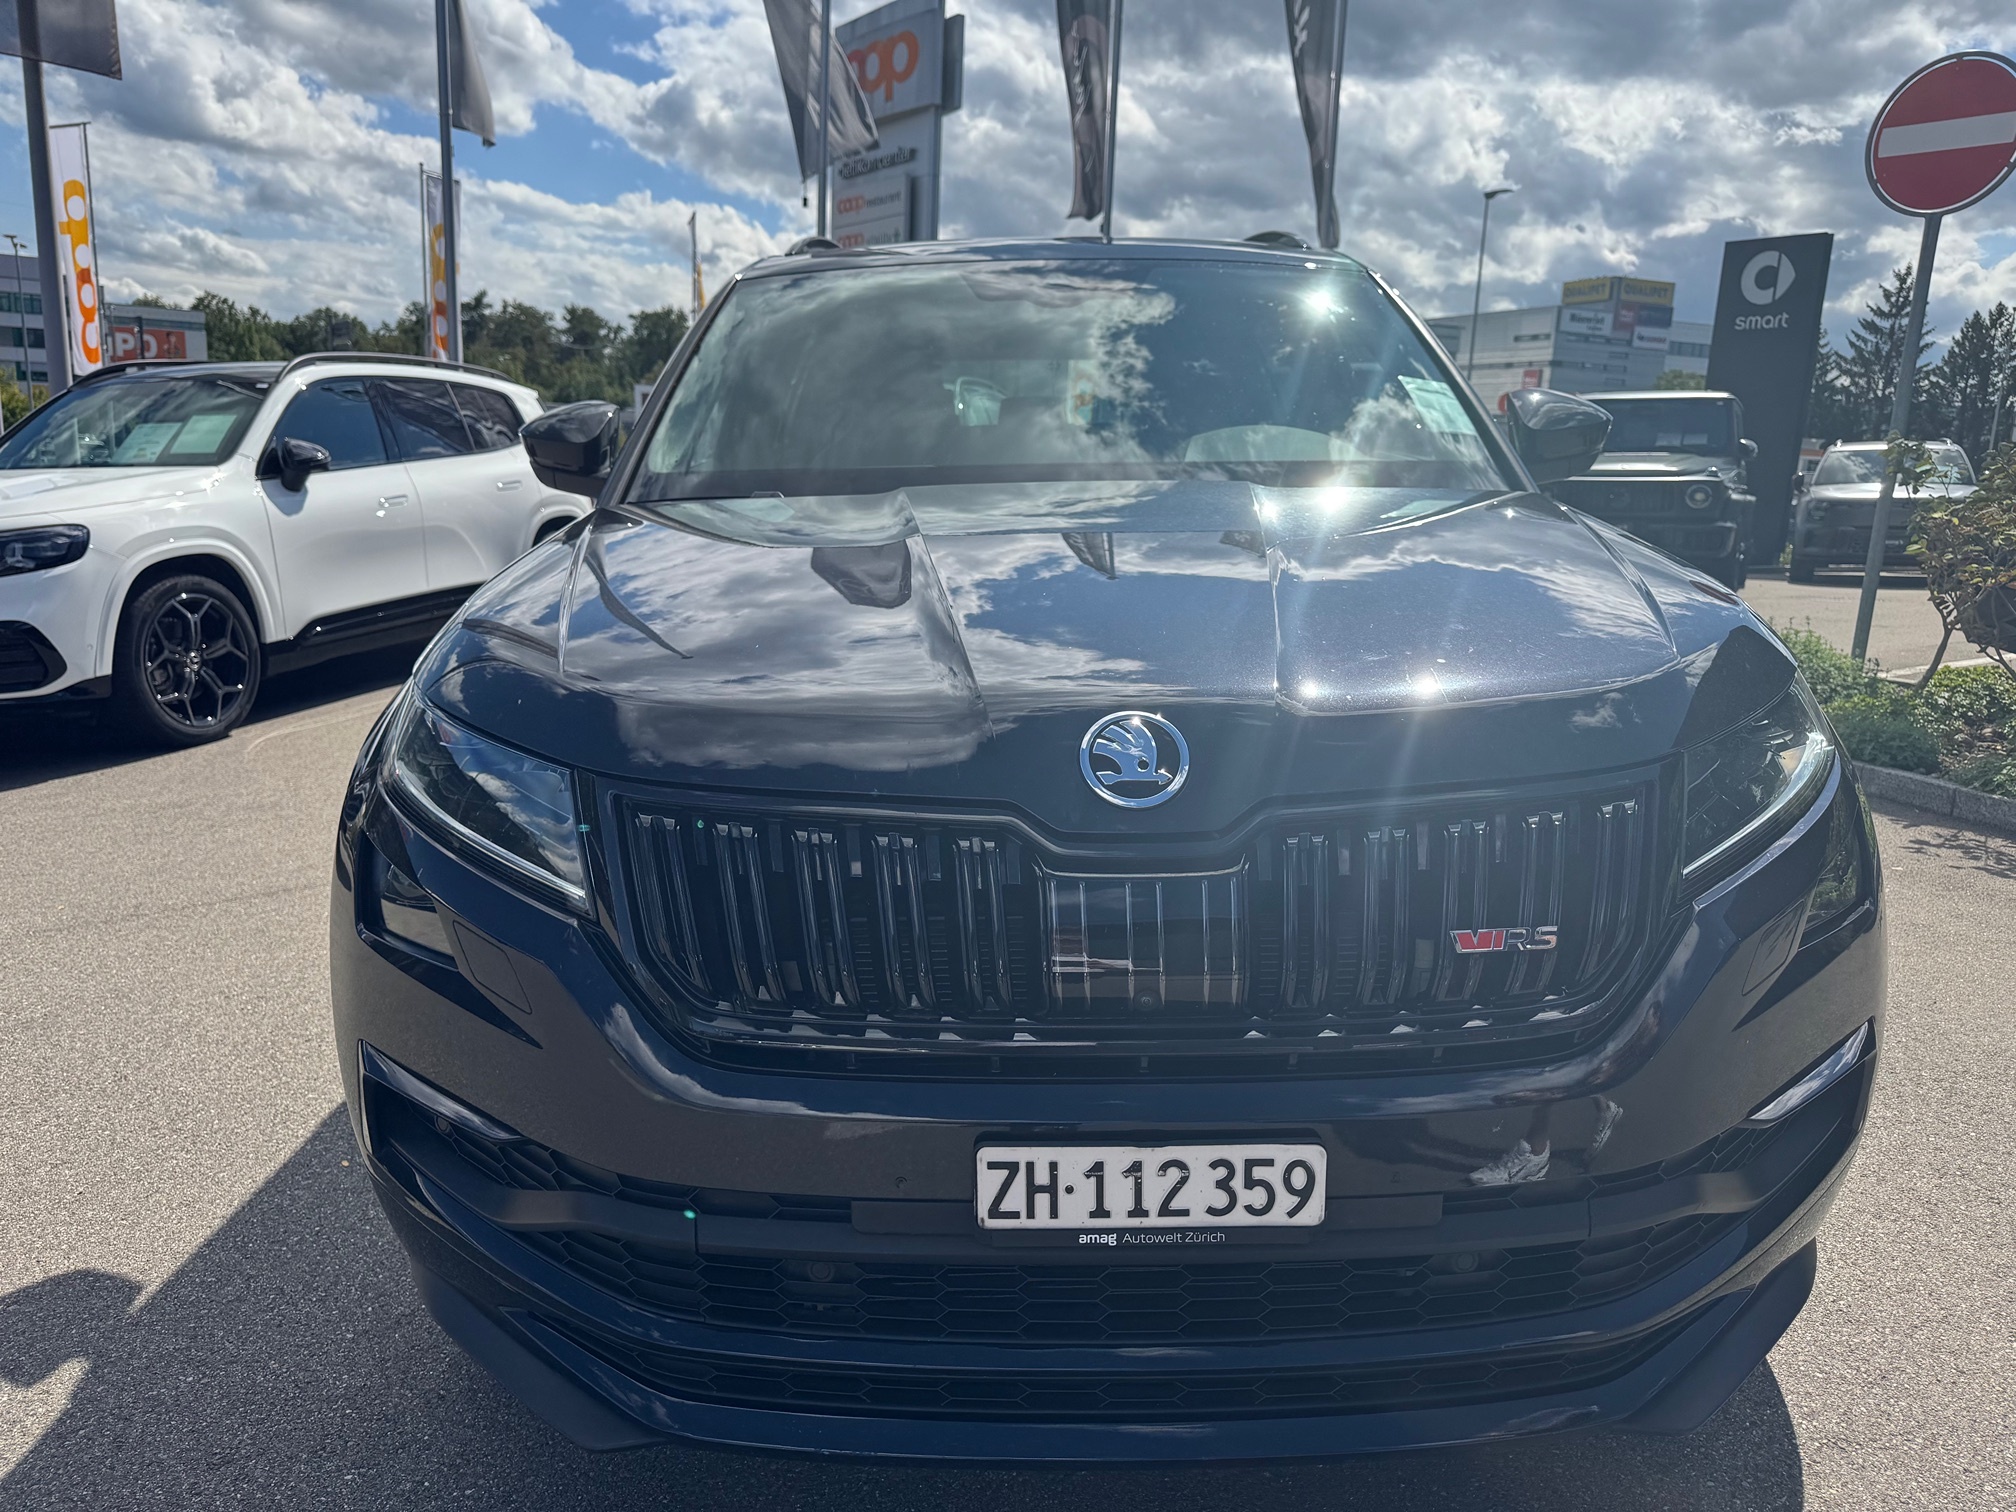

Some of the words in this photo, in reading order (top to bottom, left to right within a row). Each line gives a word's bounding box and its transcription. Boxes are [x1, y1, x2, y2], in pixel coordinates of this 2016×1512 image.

[1734, 311, 1790, 331] smart
[1078, 1232, 1117, 1246] amag
[1122, 1232, 1182, 1244] Autowelt
[1185, 1231, 1226, 1243] Zürich
